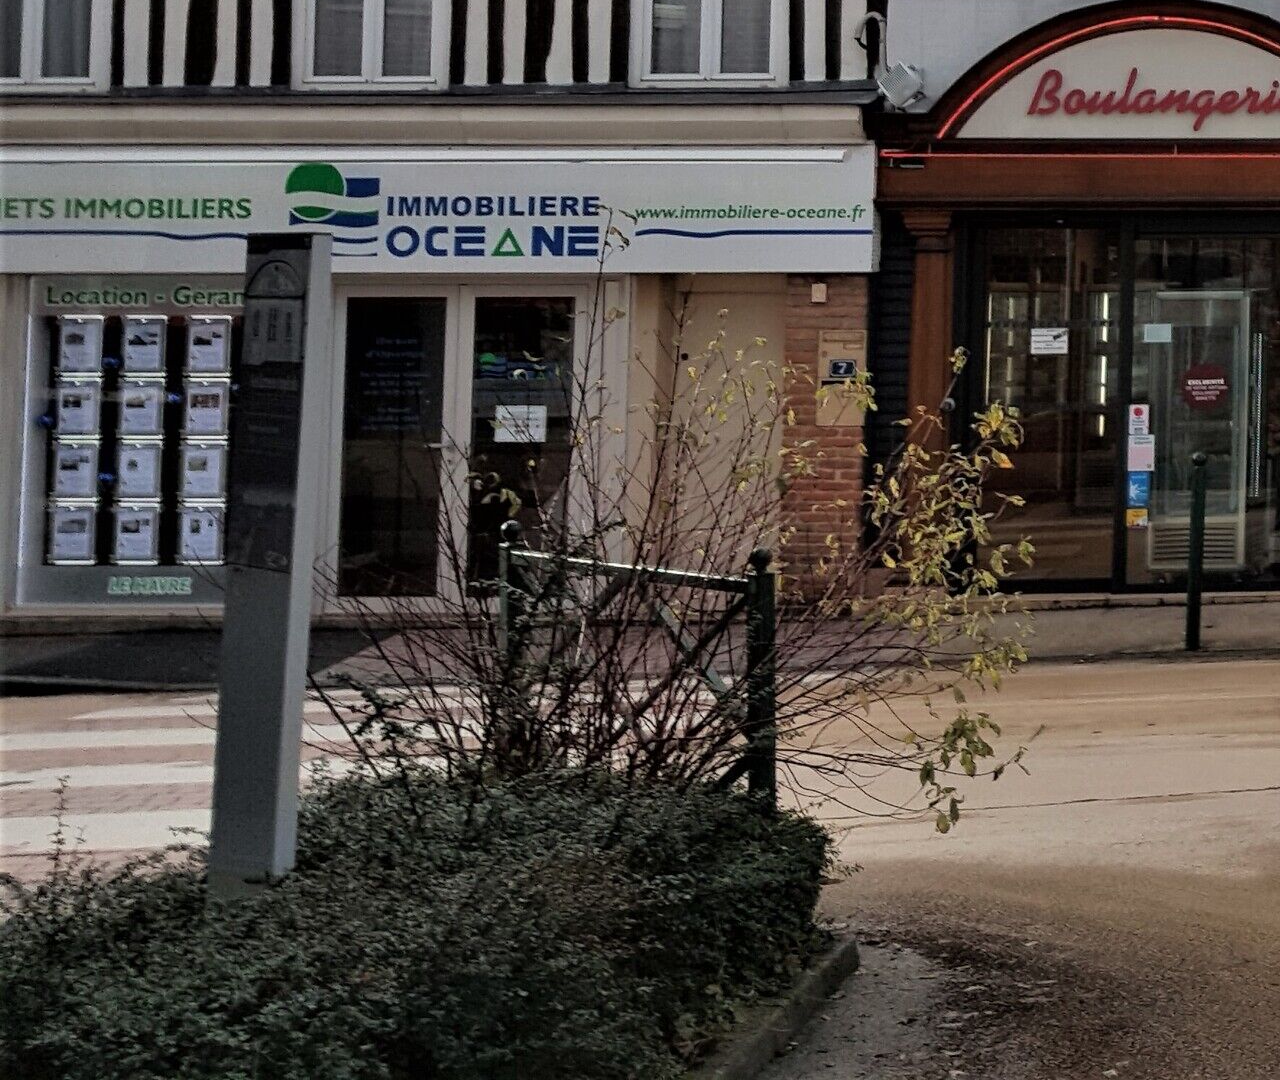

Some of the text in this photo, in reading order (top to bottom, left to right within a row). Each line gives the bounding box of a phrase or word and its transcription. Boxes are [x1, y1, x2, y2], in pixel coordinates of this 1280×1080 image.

[0, 197, 252, 219] ETS IMMOBILIERS
[386, 196, 600, 217] IMMOBILIERE
[635, 204, 867, 222] www.immobiliere-oceane.fr
[386, 226, 600, 258] OCEANE
[46, 284, 148, 306] Location
[109, 576, 192, 595] LE HAVRE
